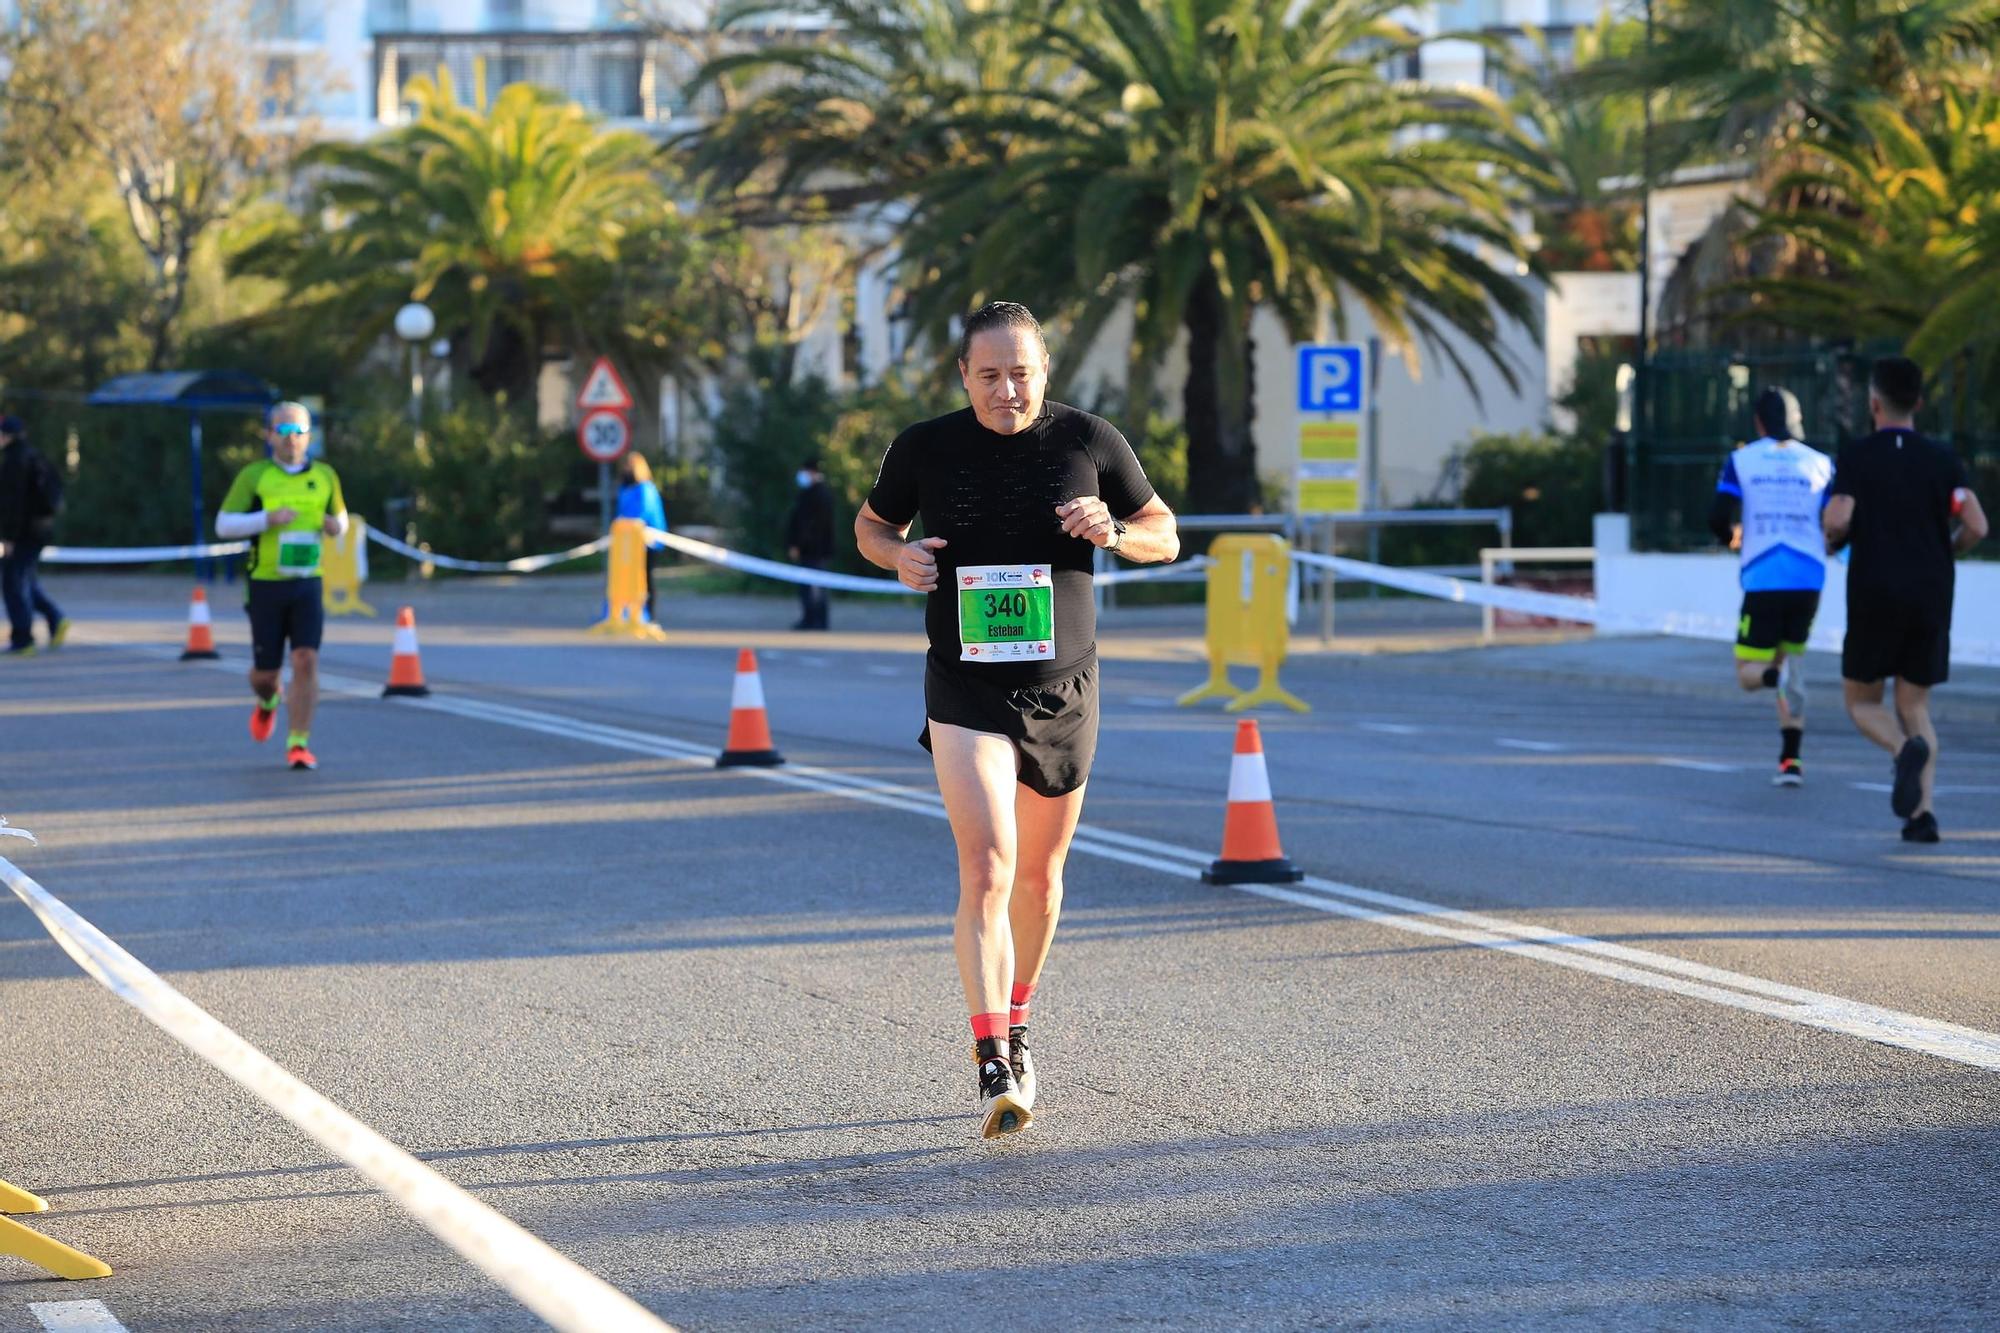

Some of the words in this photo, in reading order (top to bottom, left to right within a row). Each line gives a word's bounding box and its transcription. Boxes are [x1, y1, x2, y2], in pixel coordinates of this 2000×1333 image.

[1311, 354, 1350, 404] P
[985, 571, 1007, 582] 10K
[984, 592, 1026, 618] 340
[988, 624, 1024, 638] Esteban
